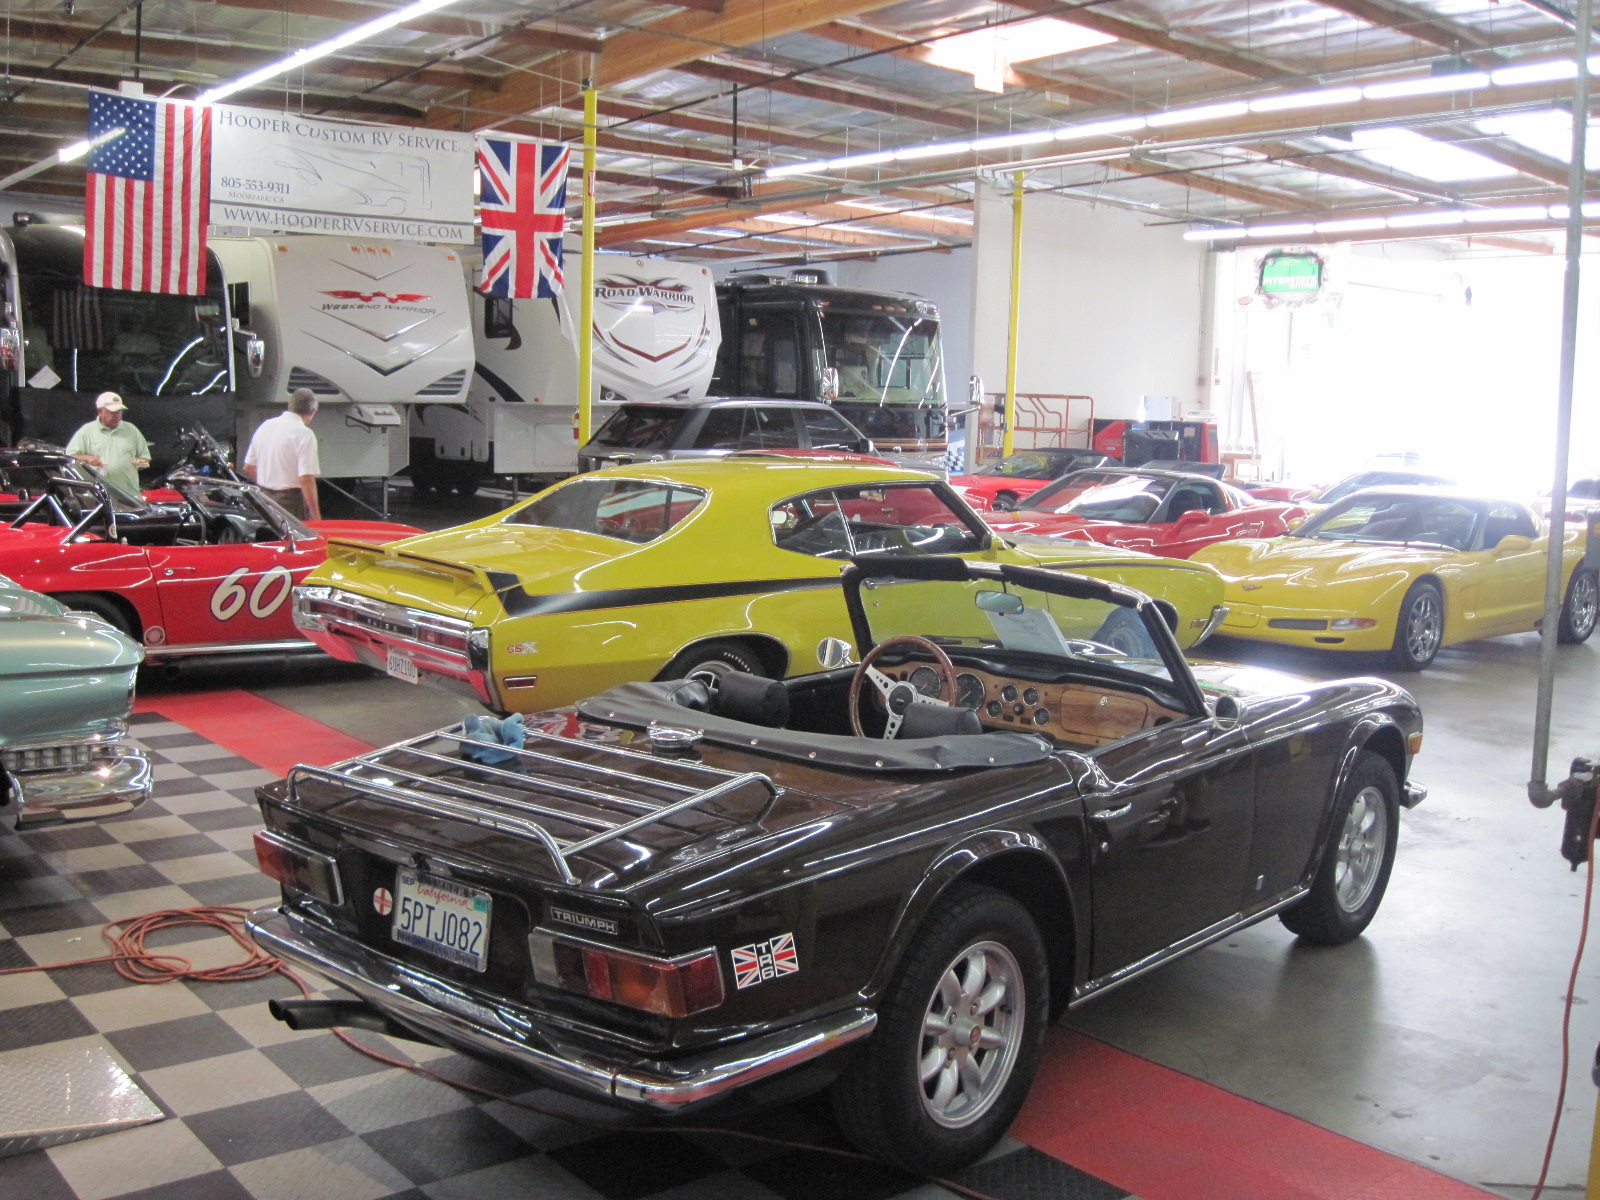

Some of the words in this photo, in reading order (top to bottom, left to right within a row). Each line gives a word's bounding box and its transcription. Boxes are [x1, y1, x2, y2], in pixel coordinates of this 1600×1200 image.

[219, 110, 292, 134] HOOPER
[295, 123, 366, 144] CUSTOM
[372, 131, 393, 146] RV
[398, 133, 459, 153] SERVICE
[221, 176, 290, 195] 805-553-9311
[273, 196, 285, 204] CA
[224, 207, 463, 239] WWW.HOOPERRVSERVICE.COM
[594, 286, 636, 299] ROAD
[637, 286, 695, 305] WARRIOR
[322, 303, 381, 311] WEEKEND
[384, 304, 437, 315] WARRIOR
[210, 566, 293, 620] 60
[506, 641, 539, 654] GSX
[401, 875, 416, 886] SEP
[416, 881, 474, 912] California
[400, 896, 483, 957] 5PTJ082
[554, 909, 616, 932] TRIUMPH
